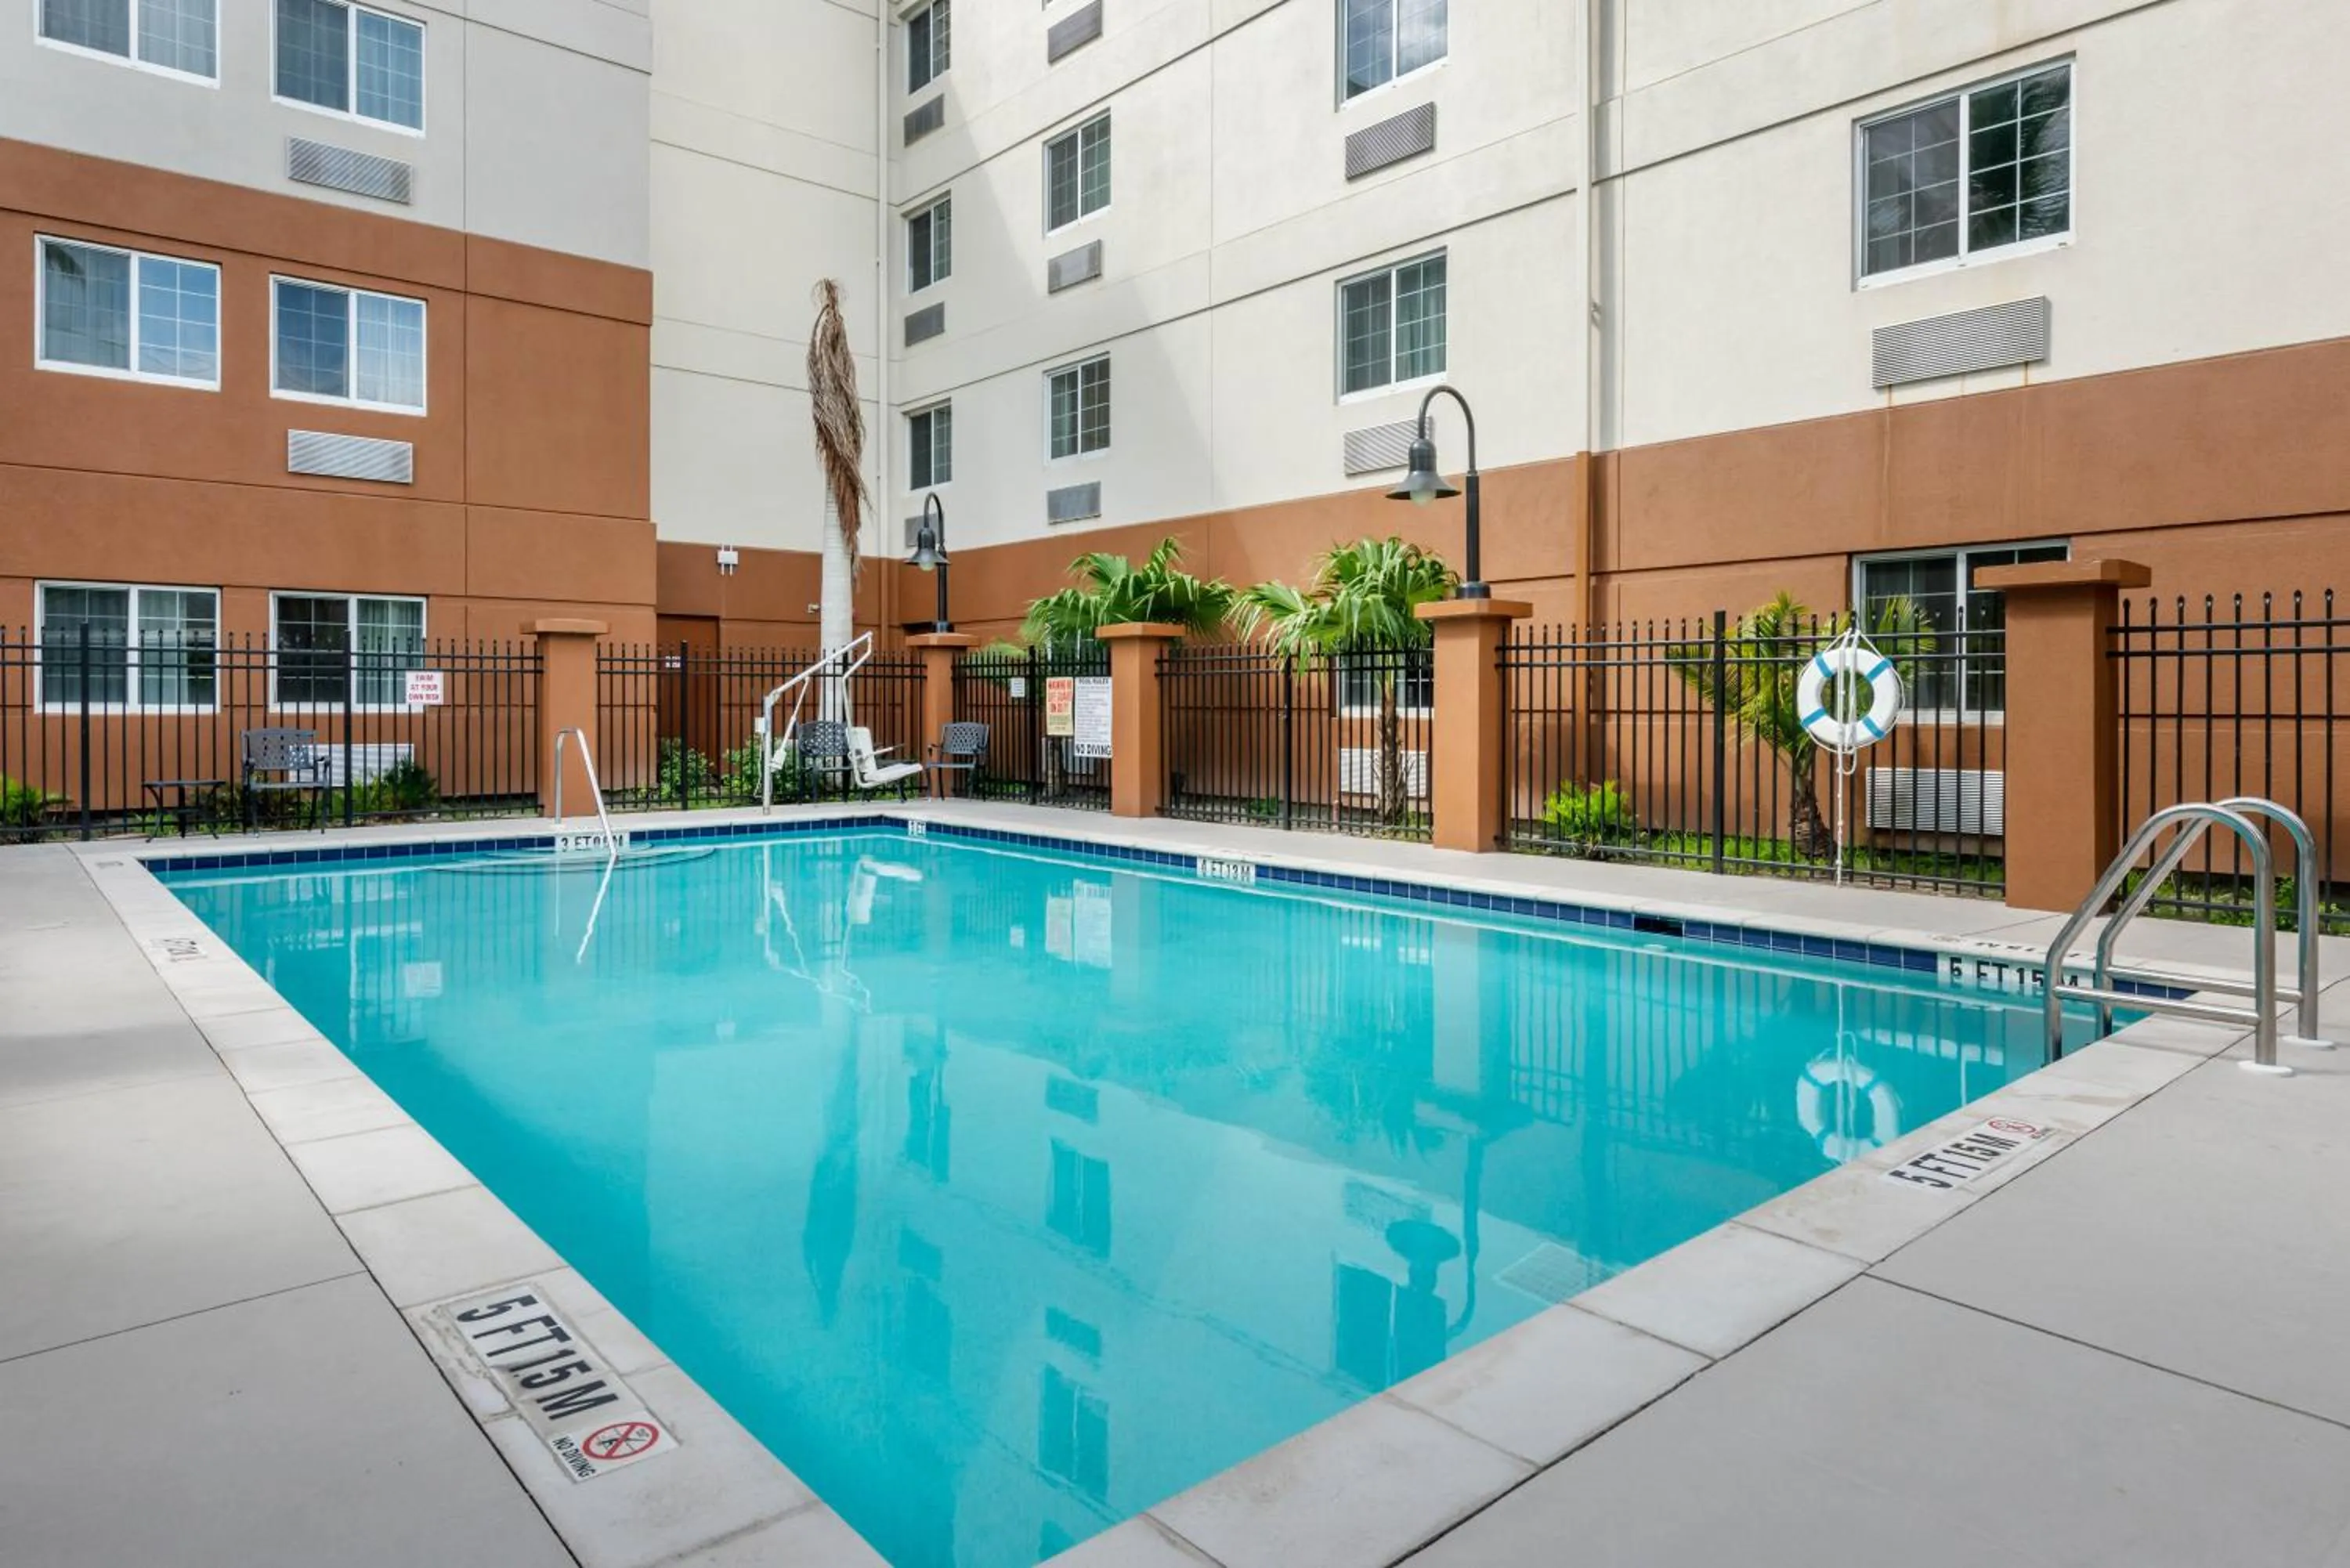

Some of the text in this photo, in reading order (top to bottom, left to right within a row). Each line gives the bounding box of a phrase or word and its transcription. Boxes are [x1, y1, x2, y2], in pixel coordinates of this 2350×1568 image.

[1076, 744, 1111, 756] NO DIVING
[1889, 1169, 1954, 1188] 5
[457, 1294, 539, 1323] 5
[551, 1436, 595, 1478] NO DIVING
